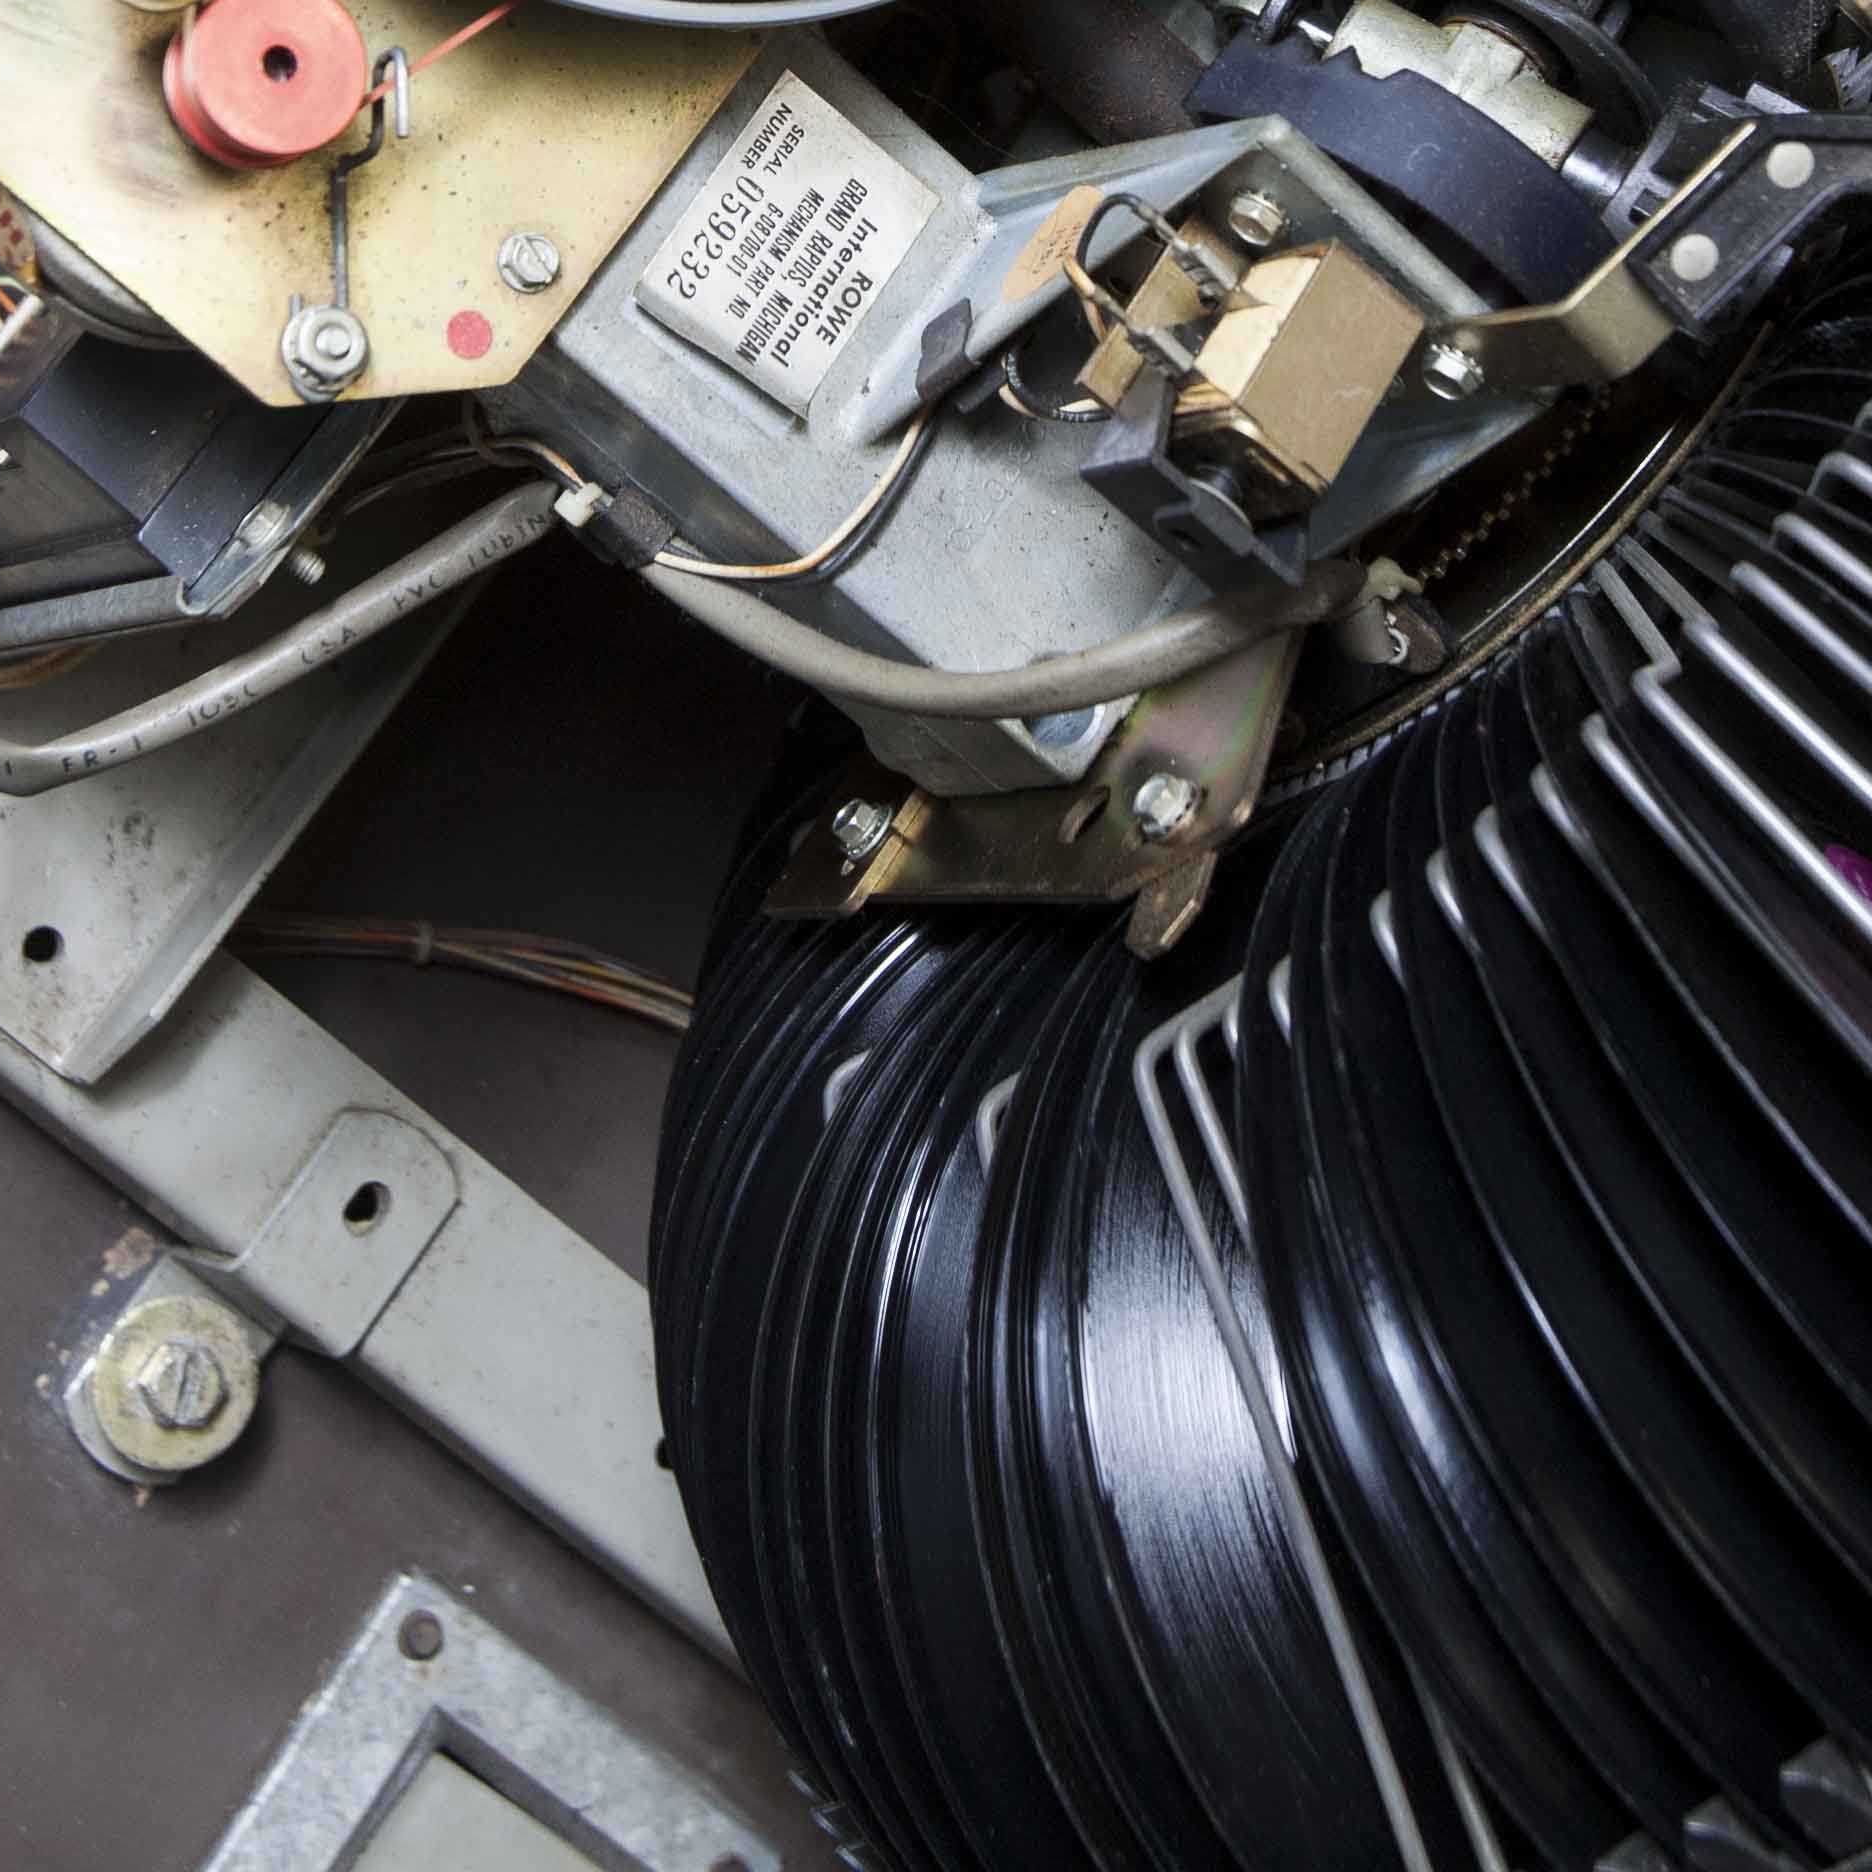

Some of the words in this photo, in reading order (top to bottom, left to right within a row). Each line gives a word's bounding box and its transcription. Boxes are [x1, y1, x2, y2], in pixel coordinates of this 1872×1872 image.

[740, 103, 793, 169] NUMBER
[762, 124, 805, 176] SERIAL
[667, 175, 766, 300] 059232
[726, 202, 784, 277] 6-08700-01
[767, 188, 825, 262] MECHANISM
[825, 178, 869, 232] GRAND
[752, 261, 777, 297] PART
[770, 217, 879, 368] International
[780, 229, 834, 288] RAPIDS,
[725, 294, 752, 320] NO.
[735, 289, 794, 366] MICHIGAN
[815, 271, 874, 346] ROWE
